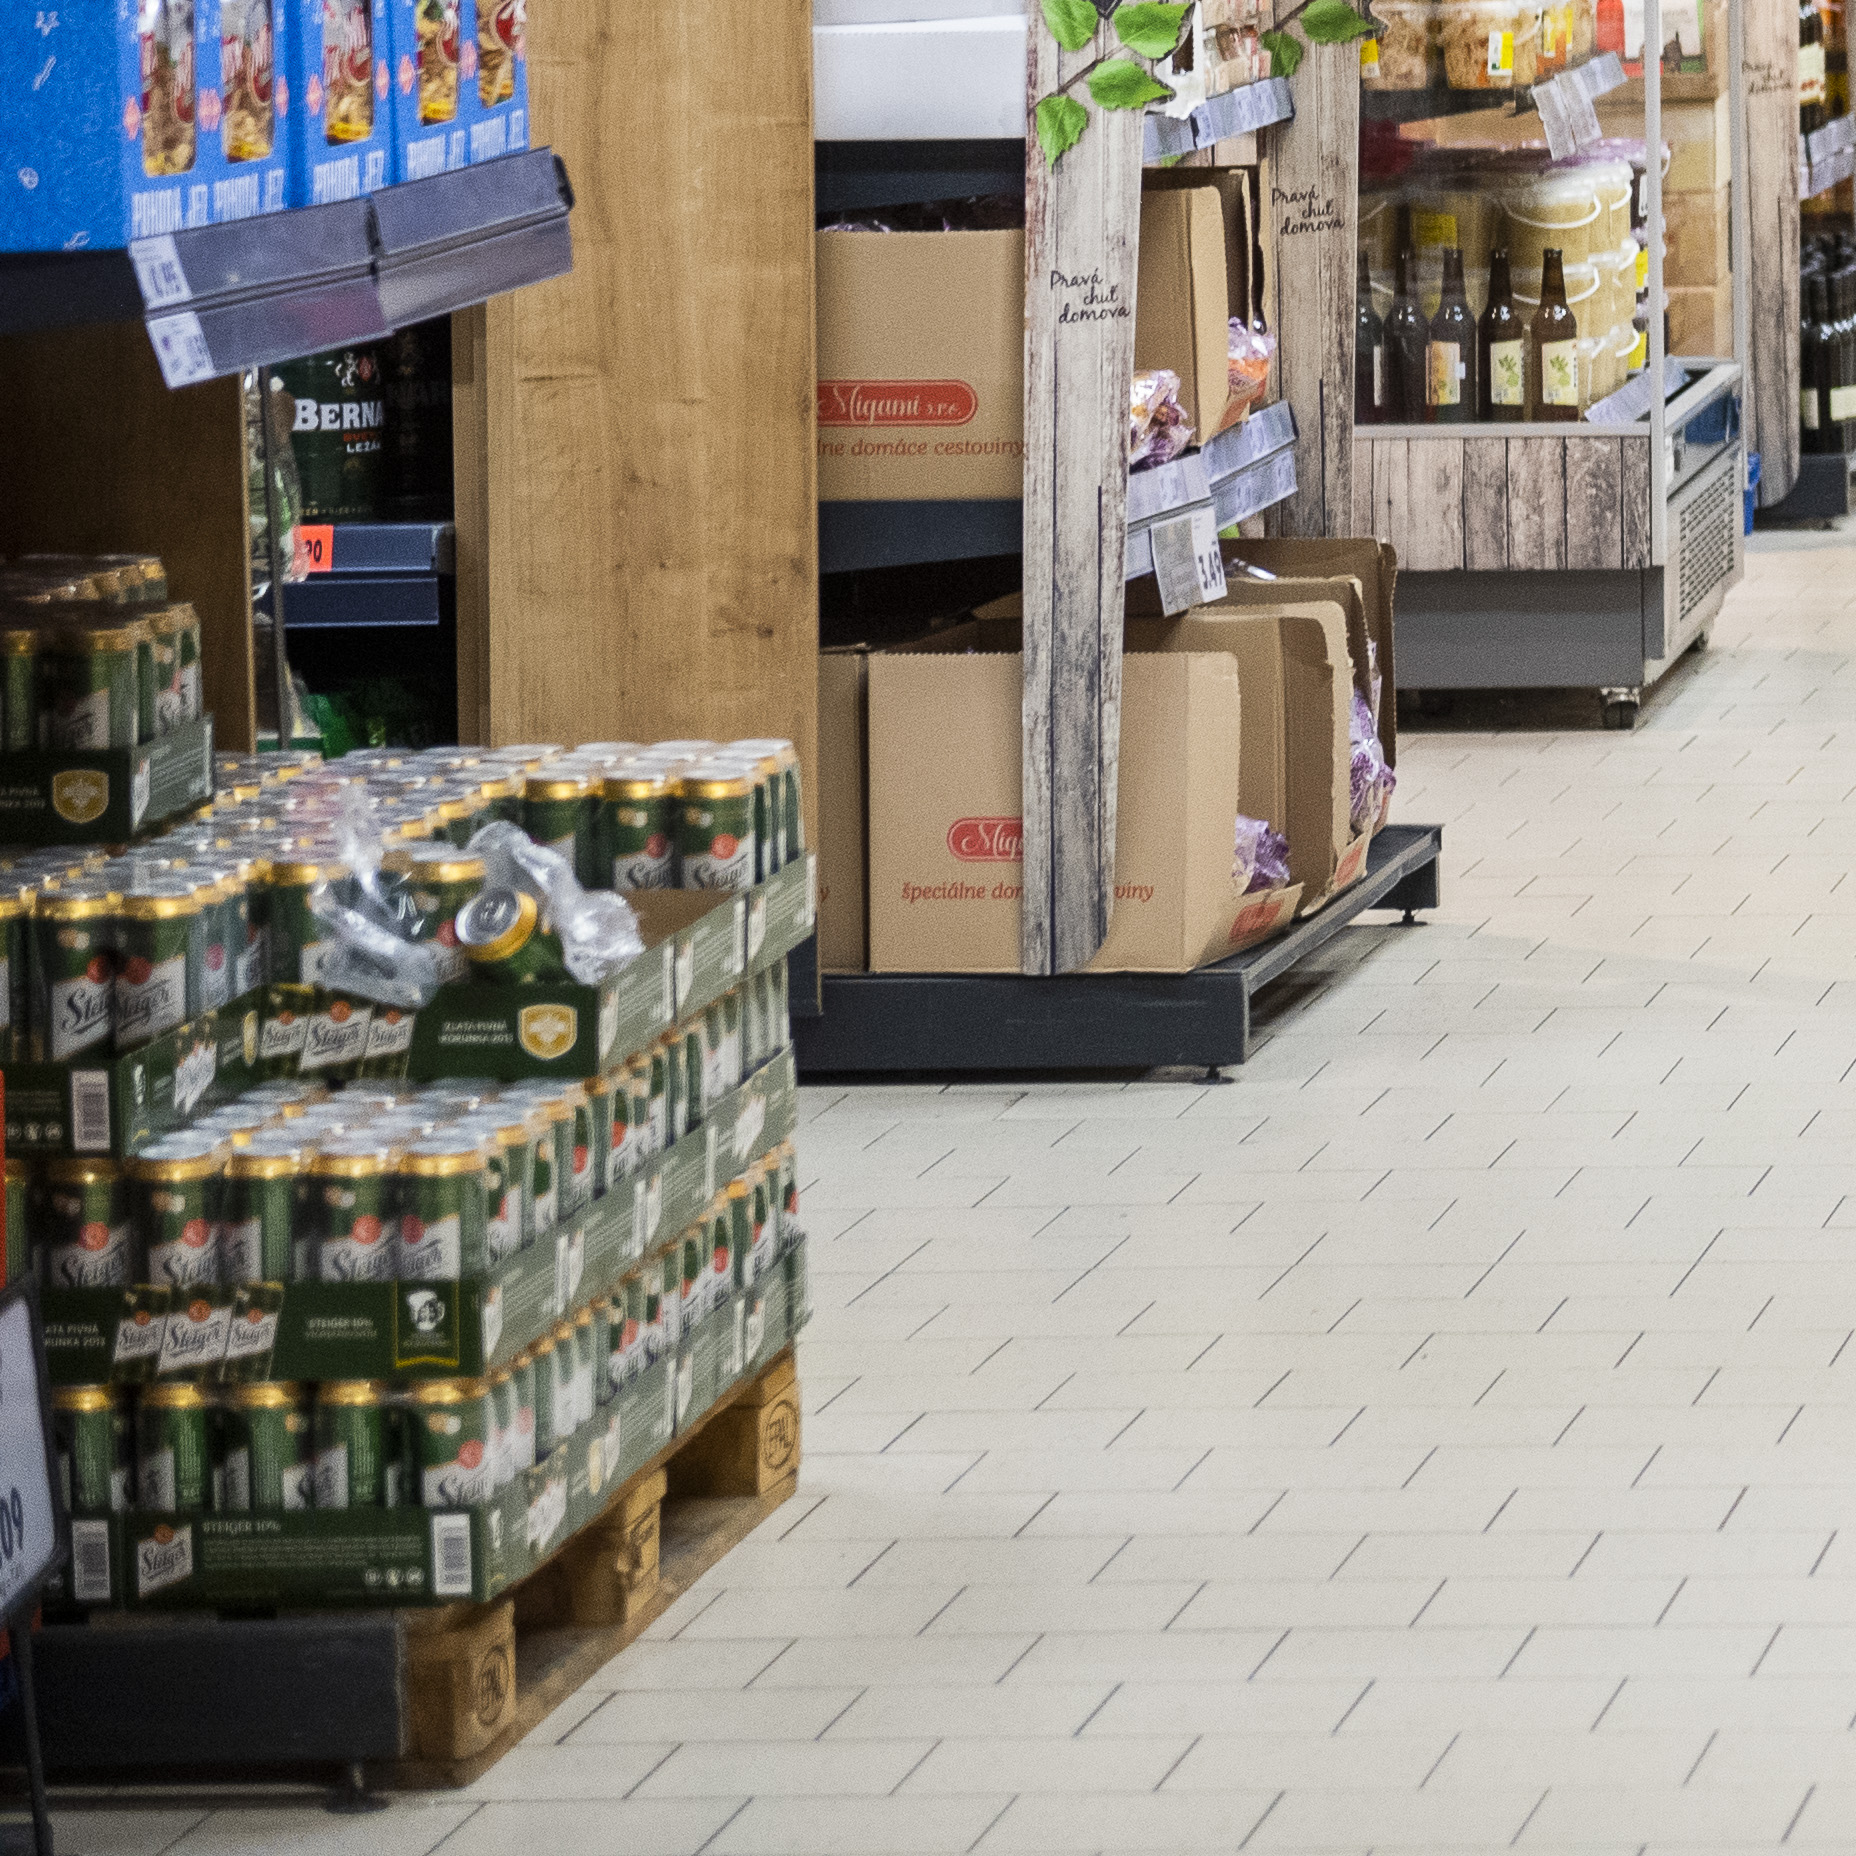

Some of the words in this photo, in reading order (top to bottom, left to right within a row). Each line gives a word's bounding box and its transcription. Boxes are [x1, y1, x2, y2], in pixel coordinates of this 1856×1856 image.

[1272, 185, 1319, 207] Pravá
[1280, 216, 1346, 236] domova
[1050, 267, 1102, 291] Pravá
[1058, 305, 1131, 324] domova
[851, 439, 928, 456] domáce
[934, 438, 1025, 460] cestoviny
[902, 882, 986, 902] špeciálne
